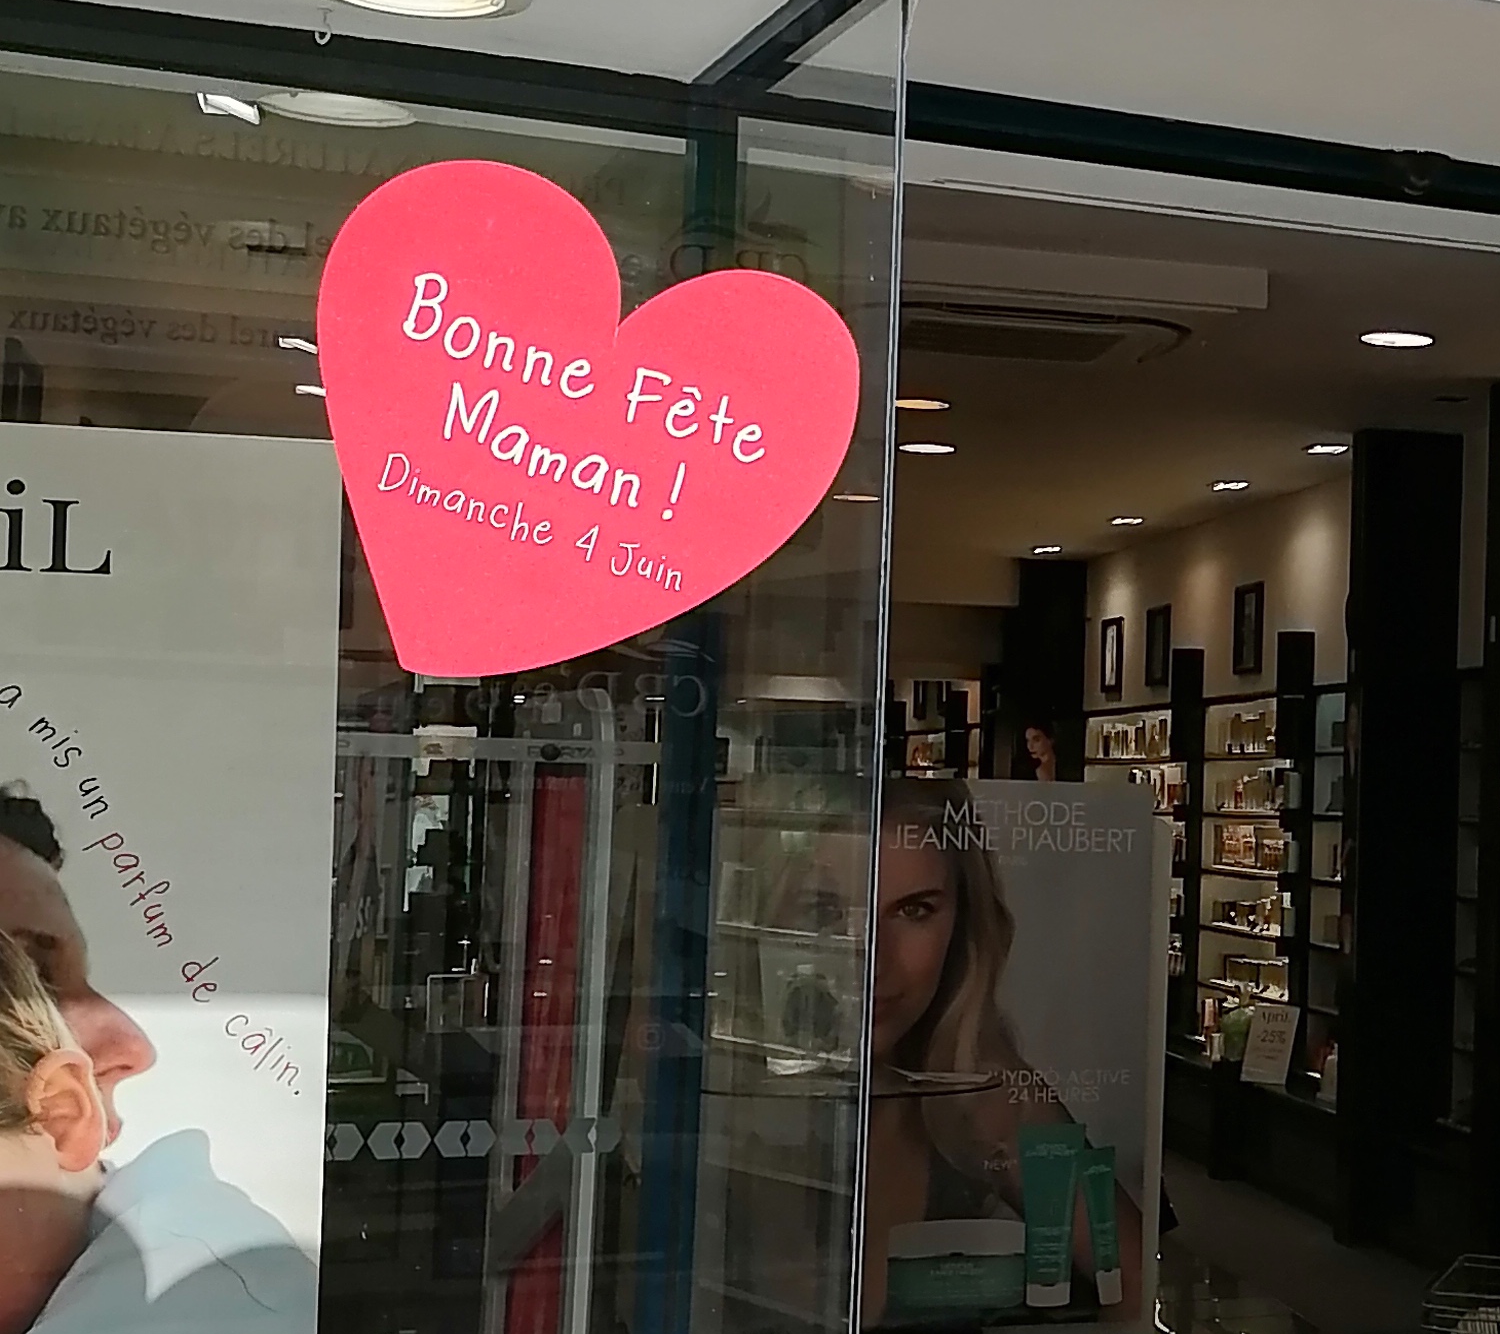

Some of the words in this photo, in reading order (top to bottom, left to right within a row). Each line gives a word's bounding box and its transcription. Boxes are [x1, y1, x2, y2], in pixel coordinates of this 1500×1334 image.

[403, 272, 594, 399] Bonne
[624, 366, 767, 464] Fête
[444, 382, 640, 510] Maman
[662, 462, 687, 521] !
[378, 452, 552, 545] Dimanche
[576, 525, 599, 561] 4
[610, 540, 684, 593] Juin
[29, 715, 82, 769] mis
[78, 775, 110, 820] un
[890, 824, 1000, 851] JEANNE
[1011, 828, 1137, 853] PIAUBERT
[82, 831, 174, 949] parfum
[181, 956, 219, 1003] de
[1007, 1087, 1030, 1105] 24
[1034, 1087, 1100, 1104] HEURES
